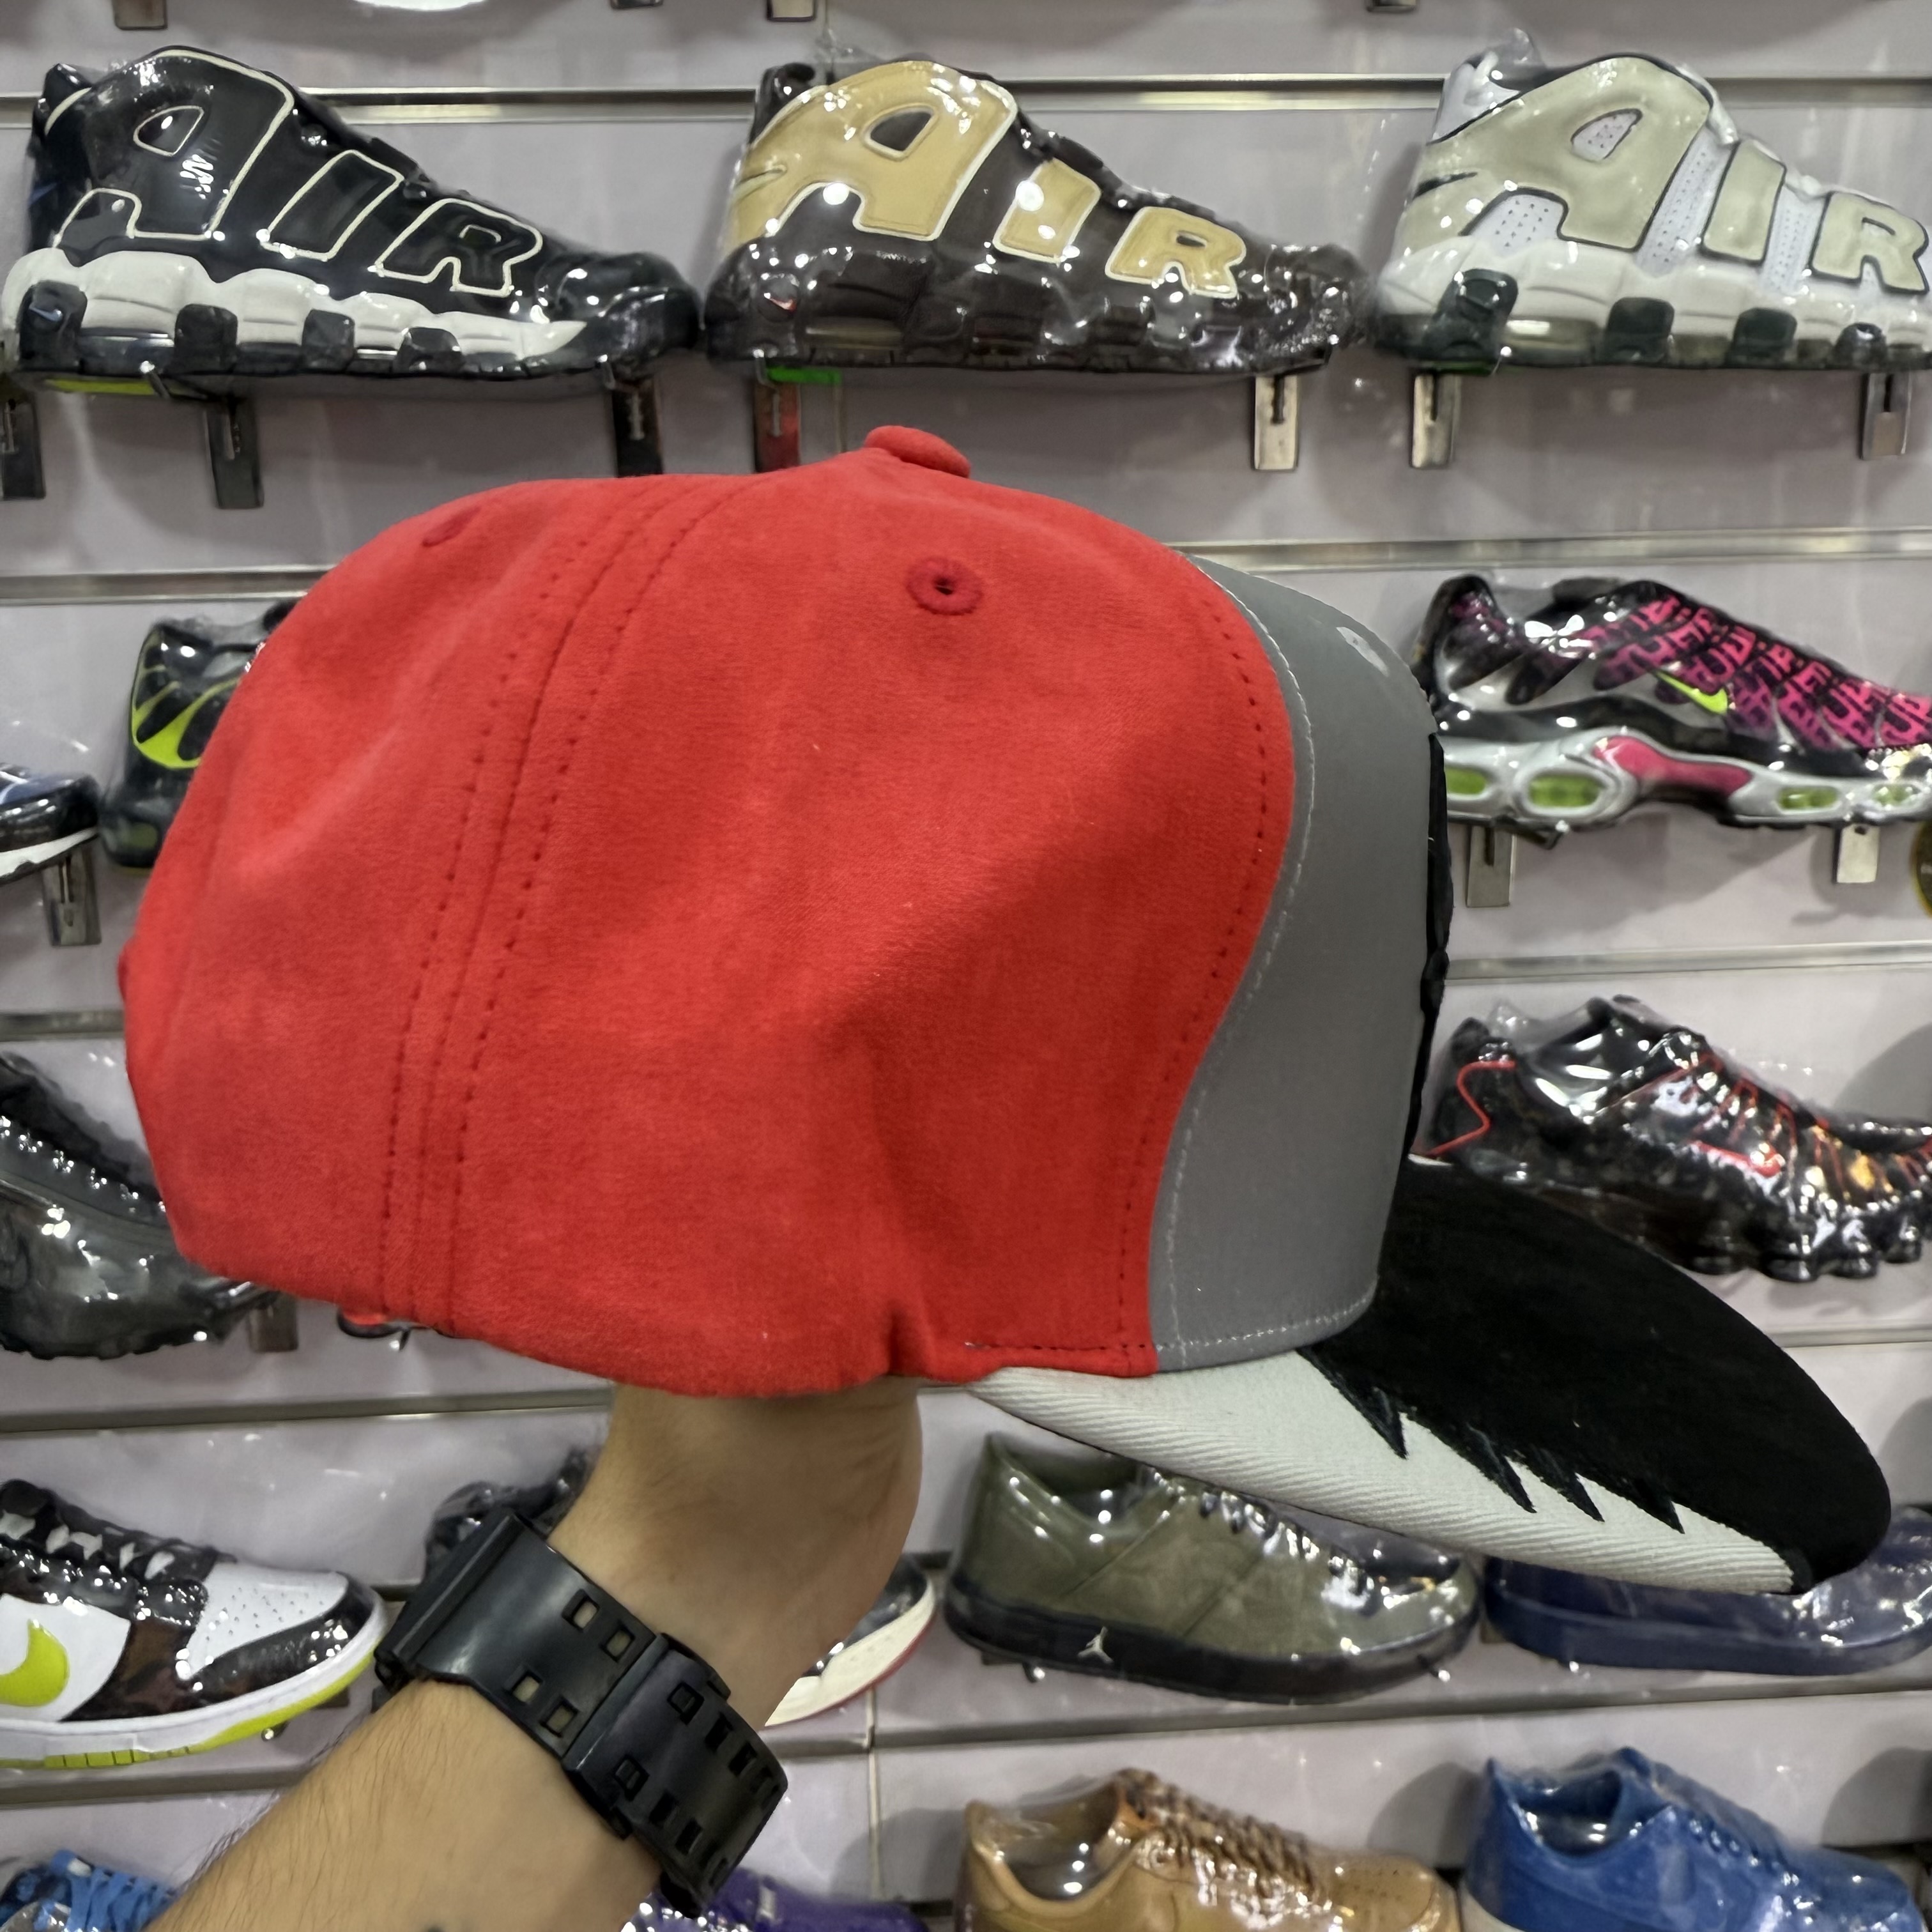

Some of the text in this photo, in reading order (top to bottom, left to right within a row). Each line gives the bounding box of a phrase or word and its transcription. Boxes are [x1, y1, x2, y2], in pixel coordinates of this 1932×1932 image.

[43, 47, 543, 298] AIR
[722, 60, 1246, 299] AIR
[1394, 53, 1930, 295] AIR
